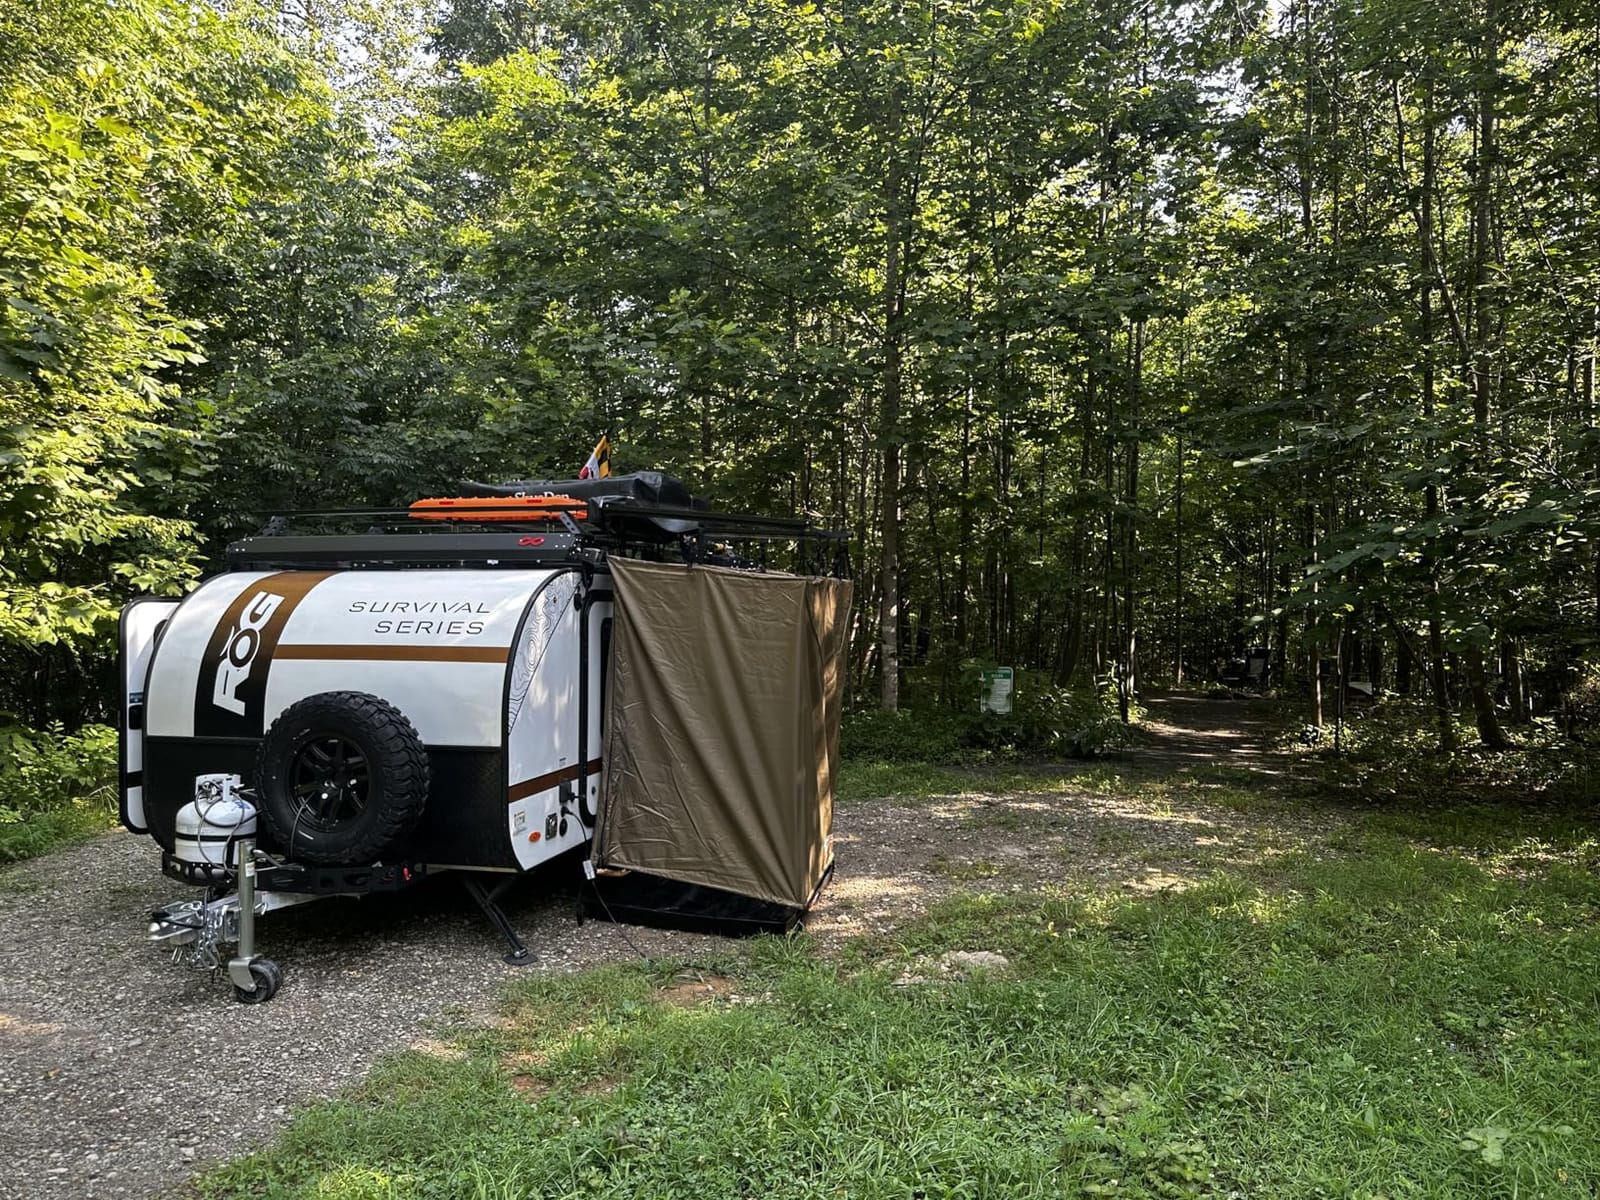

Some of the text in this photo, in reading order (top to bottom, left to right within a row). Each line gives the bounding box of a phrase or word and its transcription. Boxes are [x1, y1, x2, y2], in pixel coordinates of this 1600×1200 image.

[348, 601, 491, 614] SURVIVAL
[374, 620, 485, 635] SERIES
[212, 591, 285, 717] ROG
